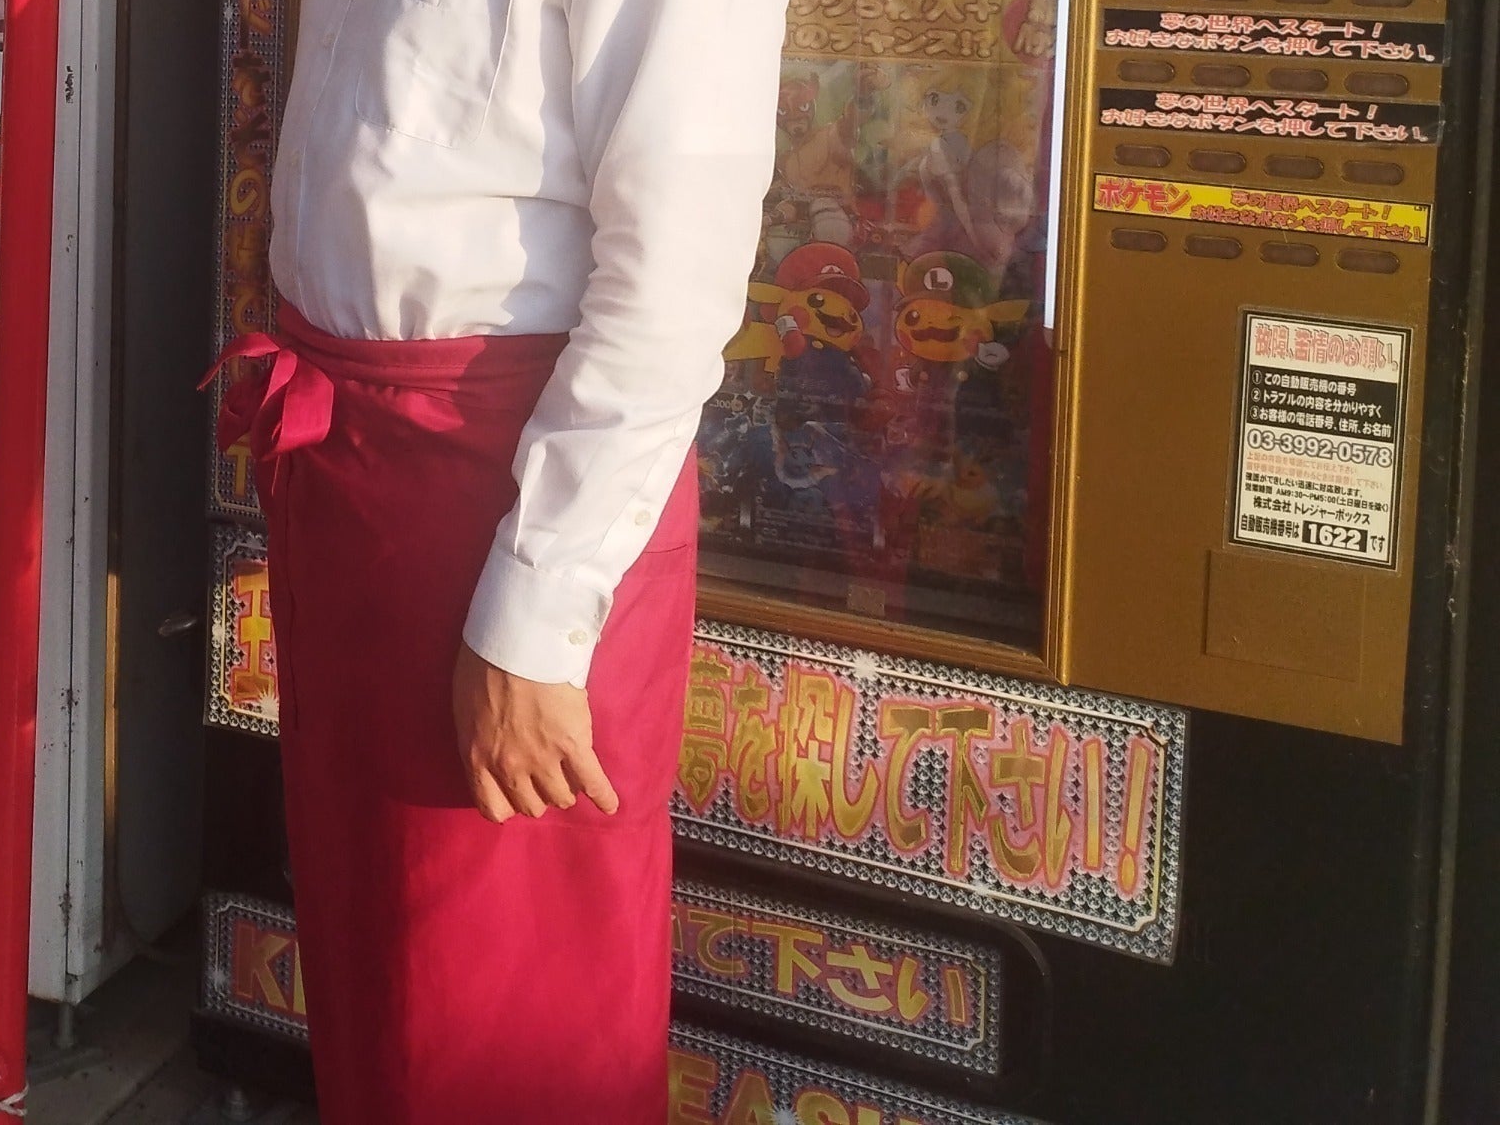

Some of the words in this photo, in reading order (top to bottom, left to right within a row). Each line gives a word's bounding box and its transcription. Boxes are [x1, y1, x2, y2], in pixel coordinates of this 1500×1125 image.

[1160, 12, 1383, 38] 夢の世界へスタート！
[1104, 29, 1435, 62] お好きなボタンを押して下さい。
[1155, 92, 1378, 120] 夢の世界へスタート！
[1101, 109, 1428, 142] お好きなボタンを押して下さい。
[1264, 373, 1357, 396] この自動販売機の番号
[1263, 392, 1382, 418] トラブルの内容を分かりやすく
[1247, 428, 1393, 467] 03-3992-0578
[1253, 496, 1291, 514] 株式会社
[1294, 501, 1371, 525] トレジャーボックス
[1308, 523, 1361, 550] 1622
[1370, 534, 1385, 553] です
